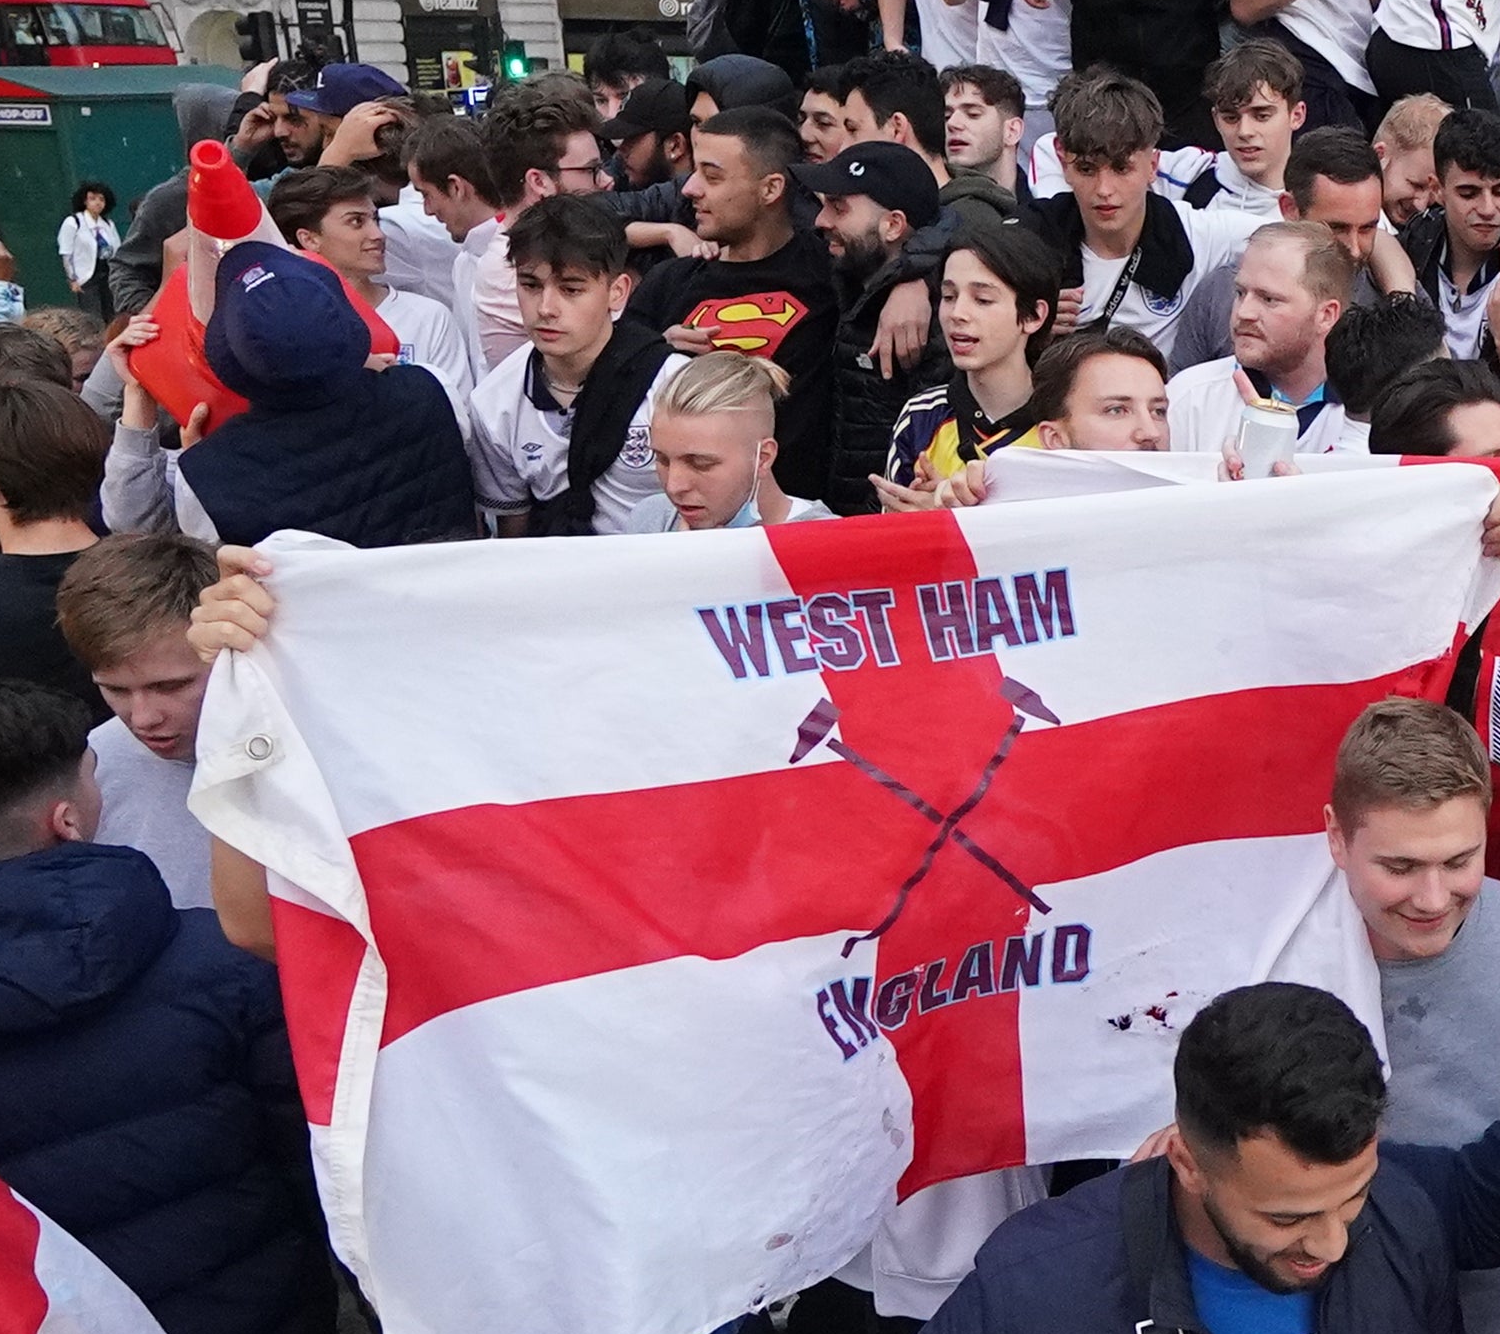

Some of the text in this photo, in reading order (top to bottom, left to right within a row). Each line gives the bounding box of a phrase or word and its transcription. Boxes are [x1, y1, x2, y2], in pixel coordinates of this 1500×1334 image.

[694, 567, 1079, 682] WEST HAM
[814, 921, 1094, 1063] ENGLAND
